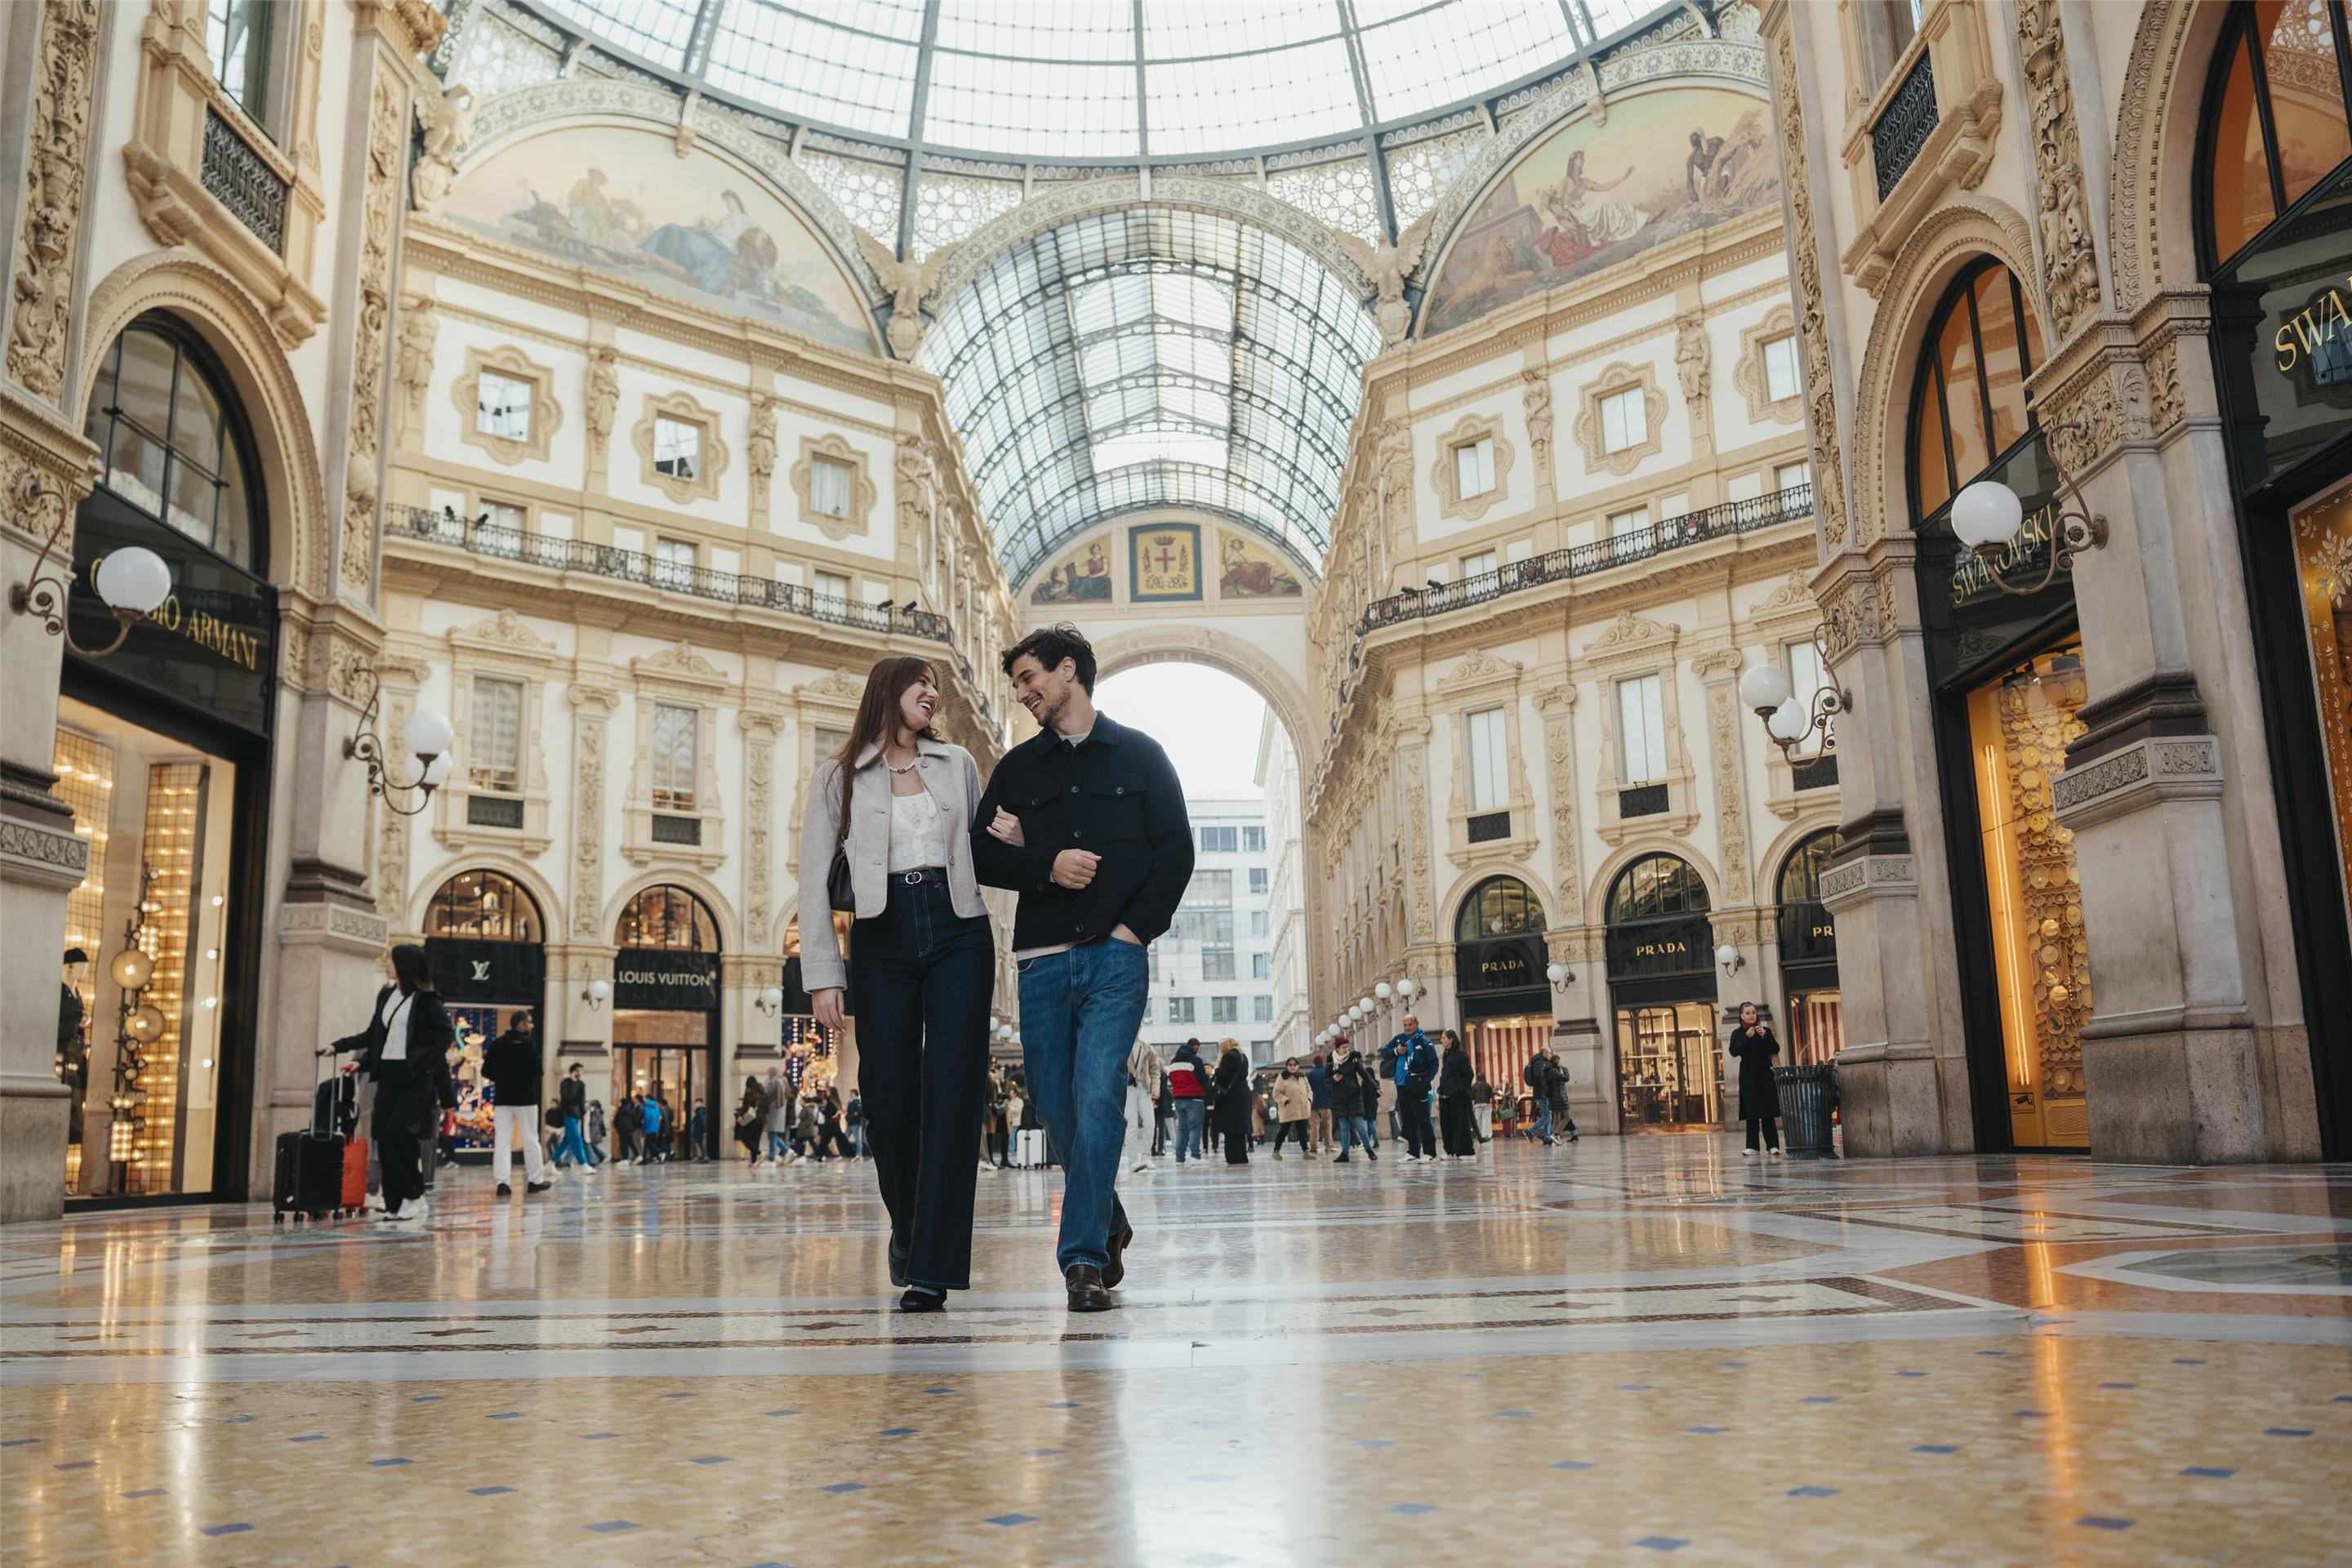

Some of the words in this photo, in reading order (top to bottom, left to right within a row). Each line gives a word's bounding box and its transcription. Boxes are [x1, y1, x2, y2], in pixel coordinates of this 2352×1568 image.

[2275, 276, 2352, 372] SWA
[185, 608, 258, 671] ARMANI
[1636, 942, 1686, 956] PRADA
[1481, 959, 1525, 973] PRADA
[619, 970, 655, 985] LOUIS
[657, 972, 710, 987] VUITTON
